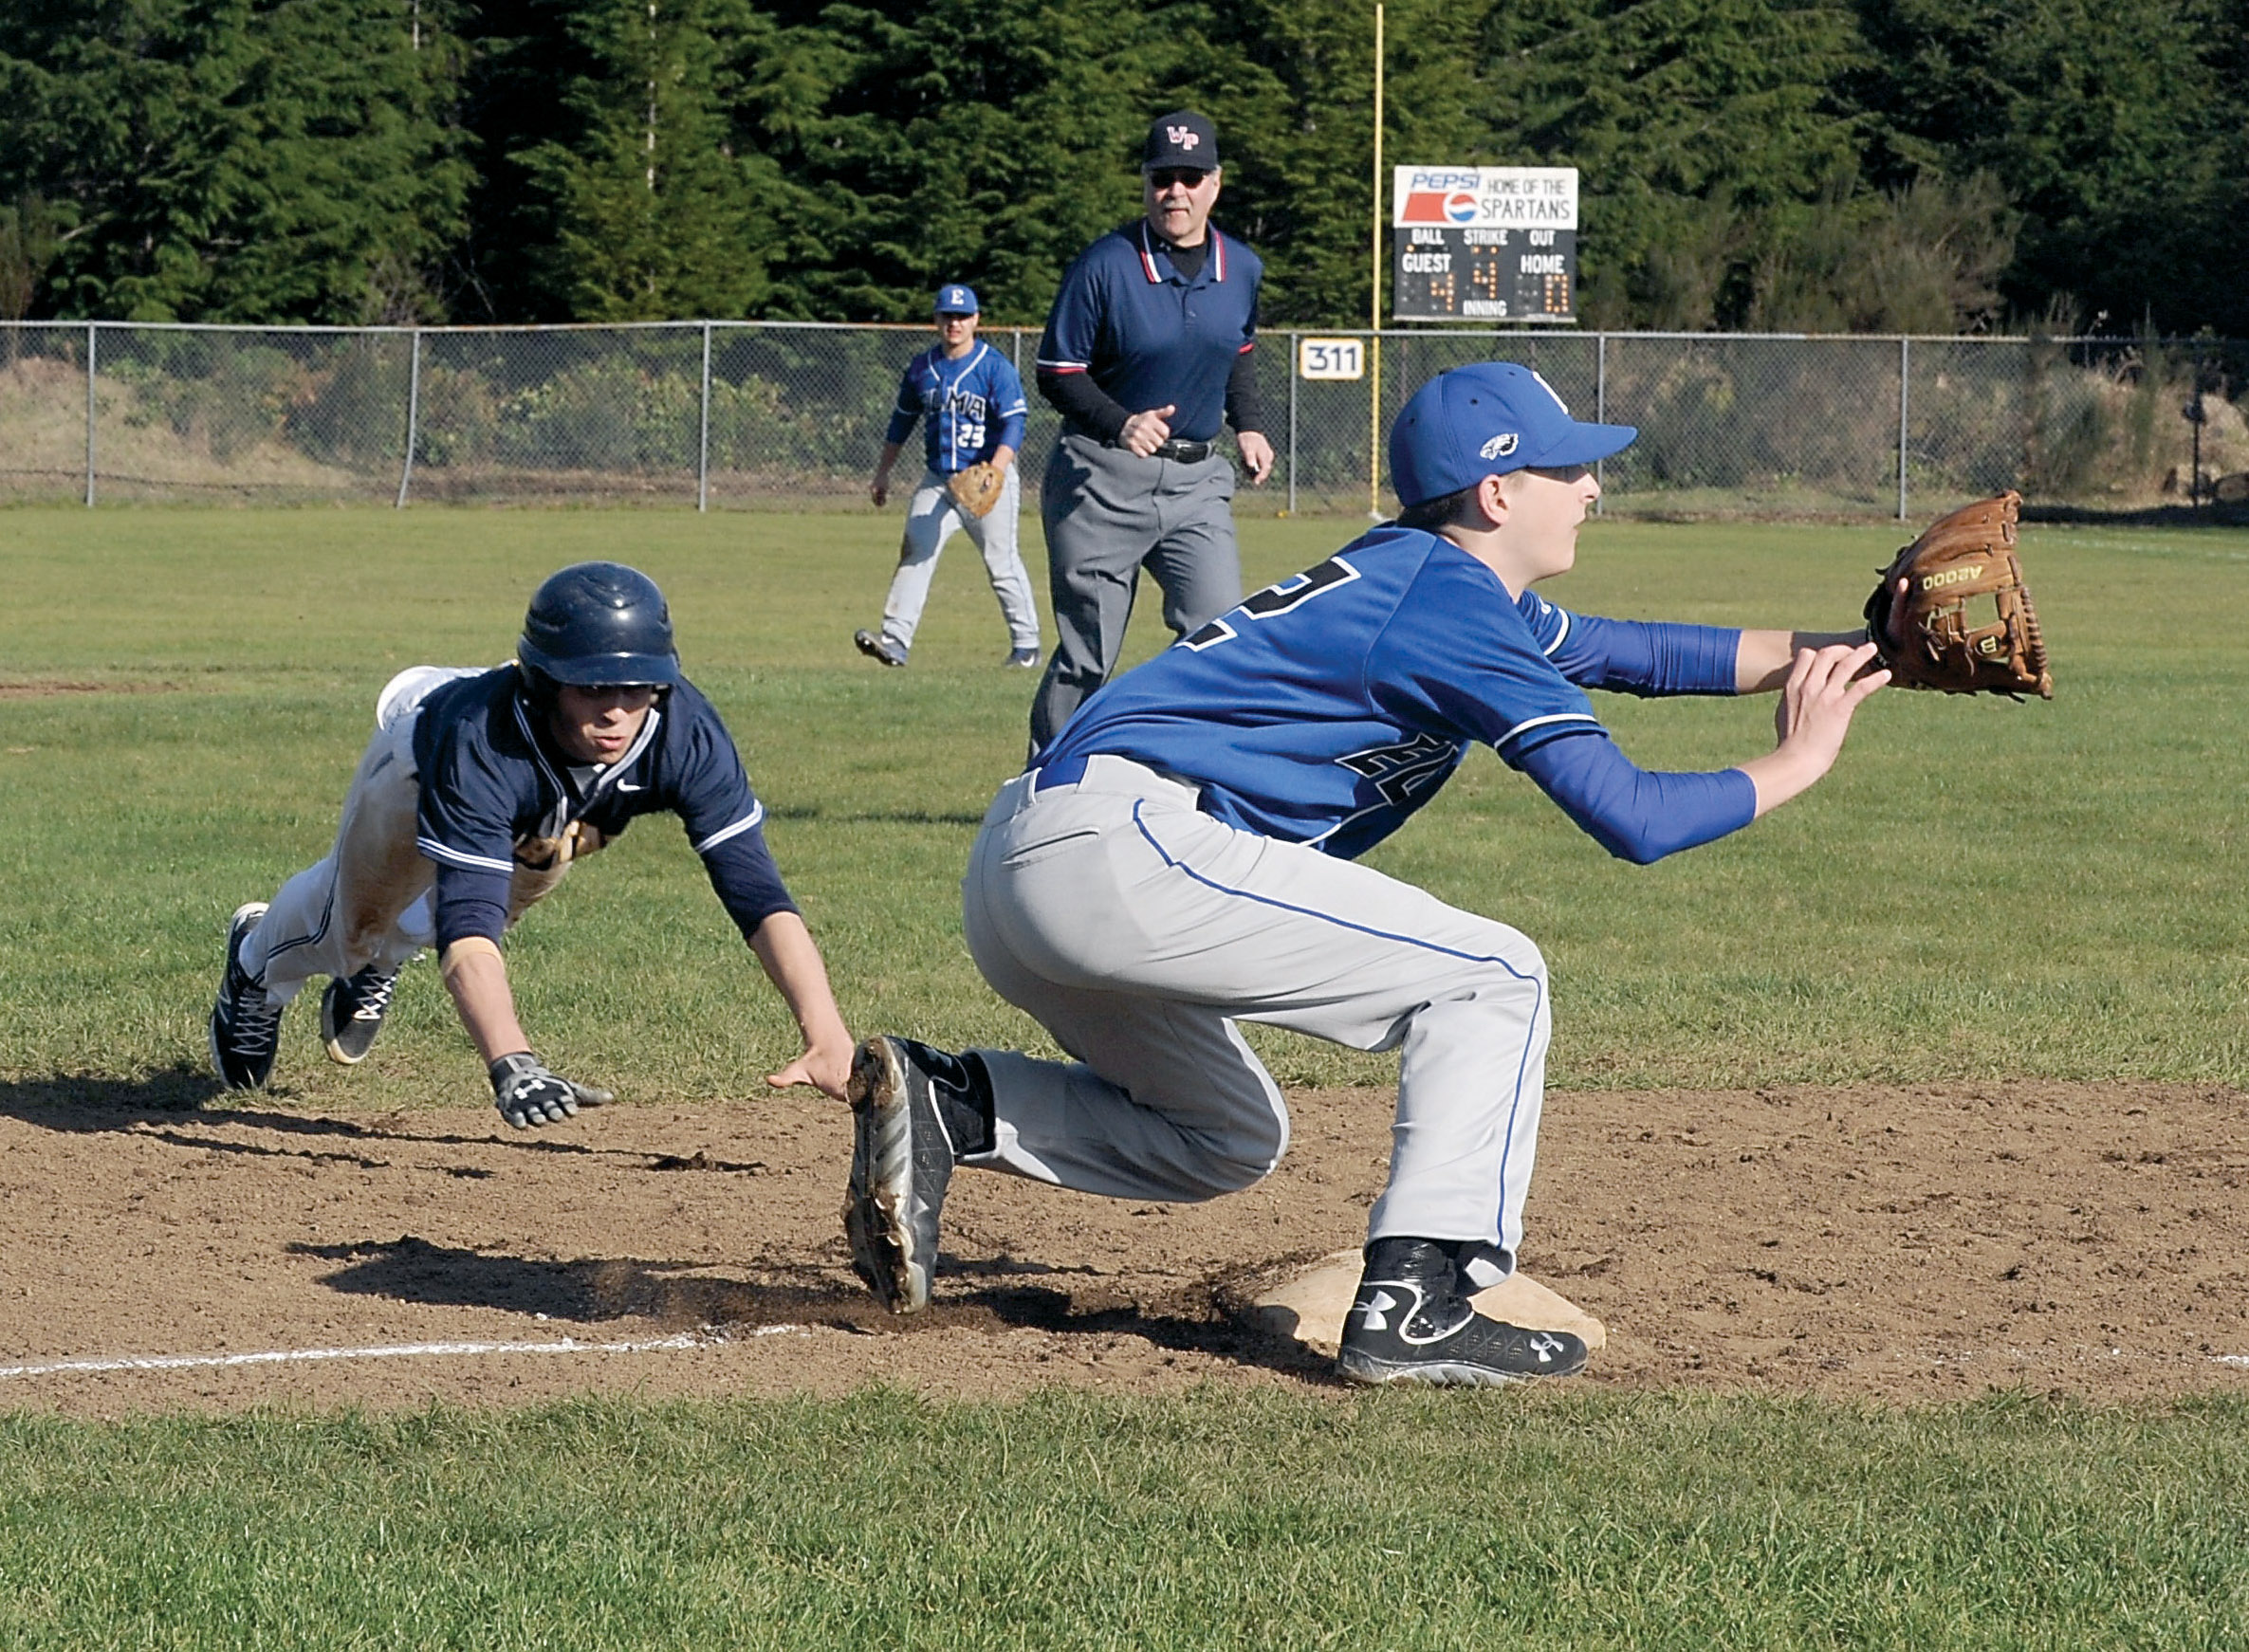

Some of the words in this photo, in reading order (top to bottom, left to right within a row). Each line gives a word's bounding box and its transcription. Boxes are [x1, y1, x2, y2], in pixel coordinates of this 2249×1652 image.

[1411, 173, 1482, 189] PEPSI
[1487, 177, 1520, 195] HOME
[1522, 177, 1538, 194] OF
[1542, 177, 1566, 195] THE
[1481, 197, 1571, 220] SPARTANS
[1411, 229, 1445, 246] BALL
[1464, 229, 1508, 246] STRIKE
[1529, 229, 1556, 247] OUT
[1402, 253, 1452, 273] GUEST
[1521, 254, 1565, 274] HOME
[951, 289, 964, 305] E
[1463, 300, 1507, 317] INNING
[1308, 346, 1356, 371] 311
[957, 423, 986, 450] 23
[1923, 565, 1982, 590] A2000
